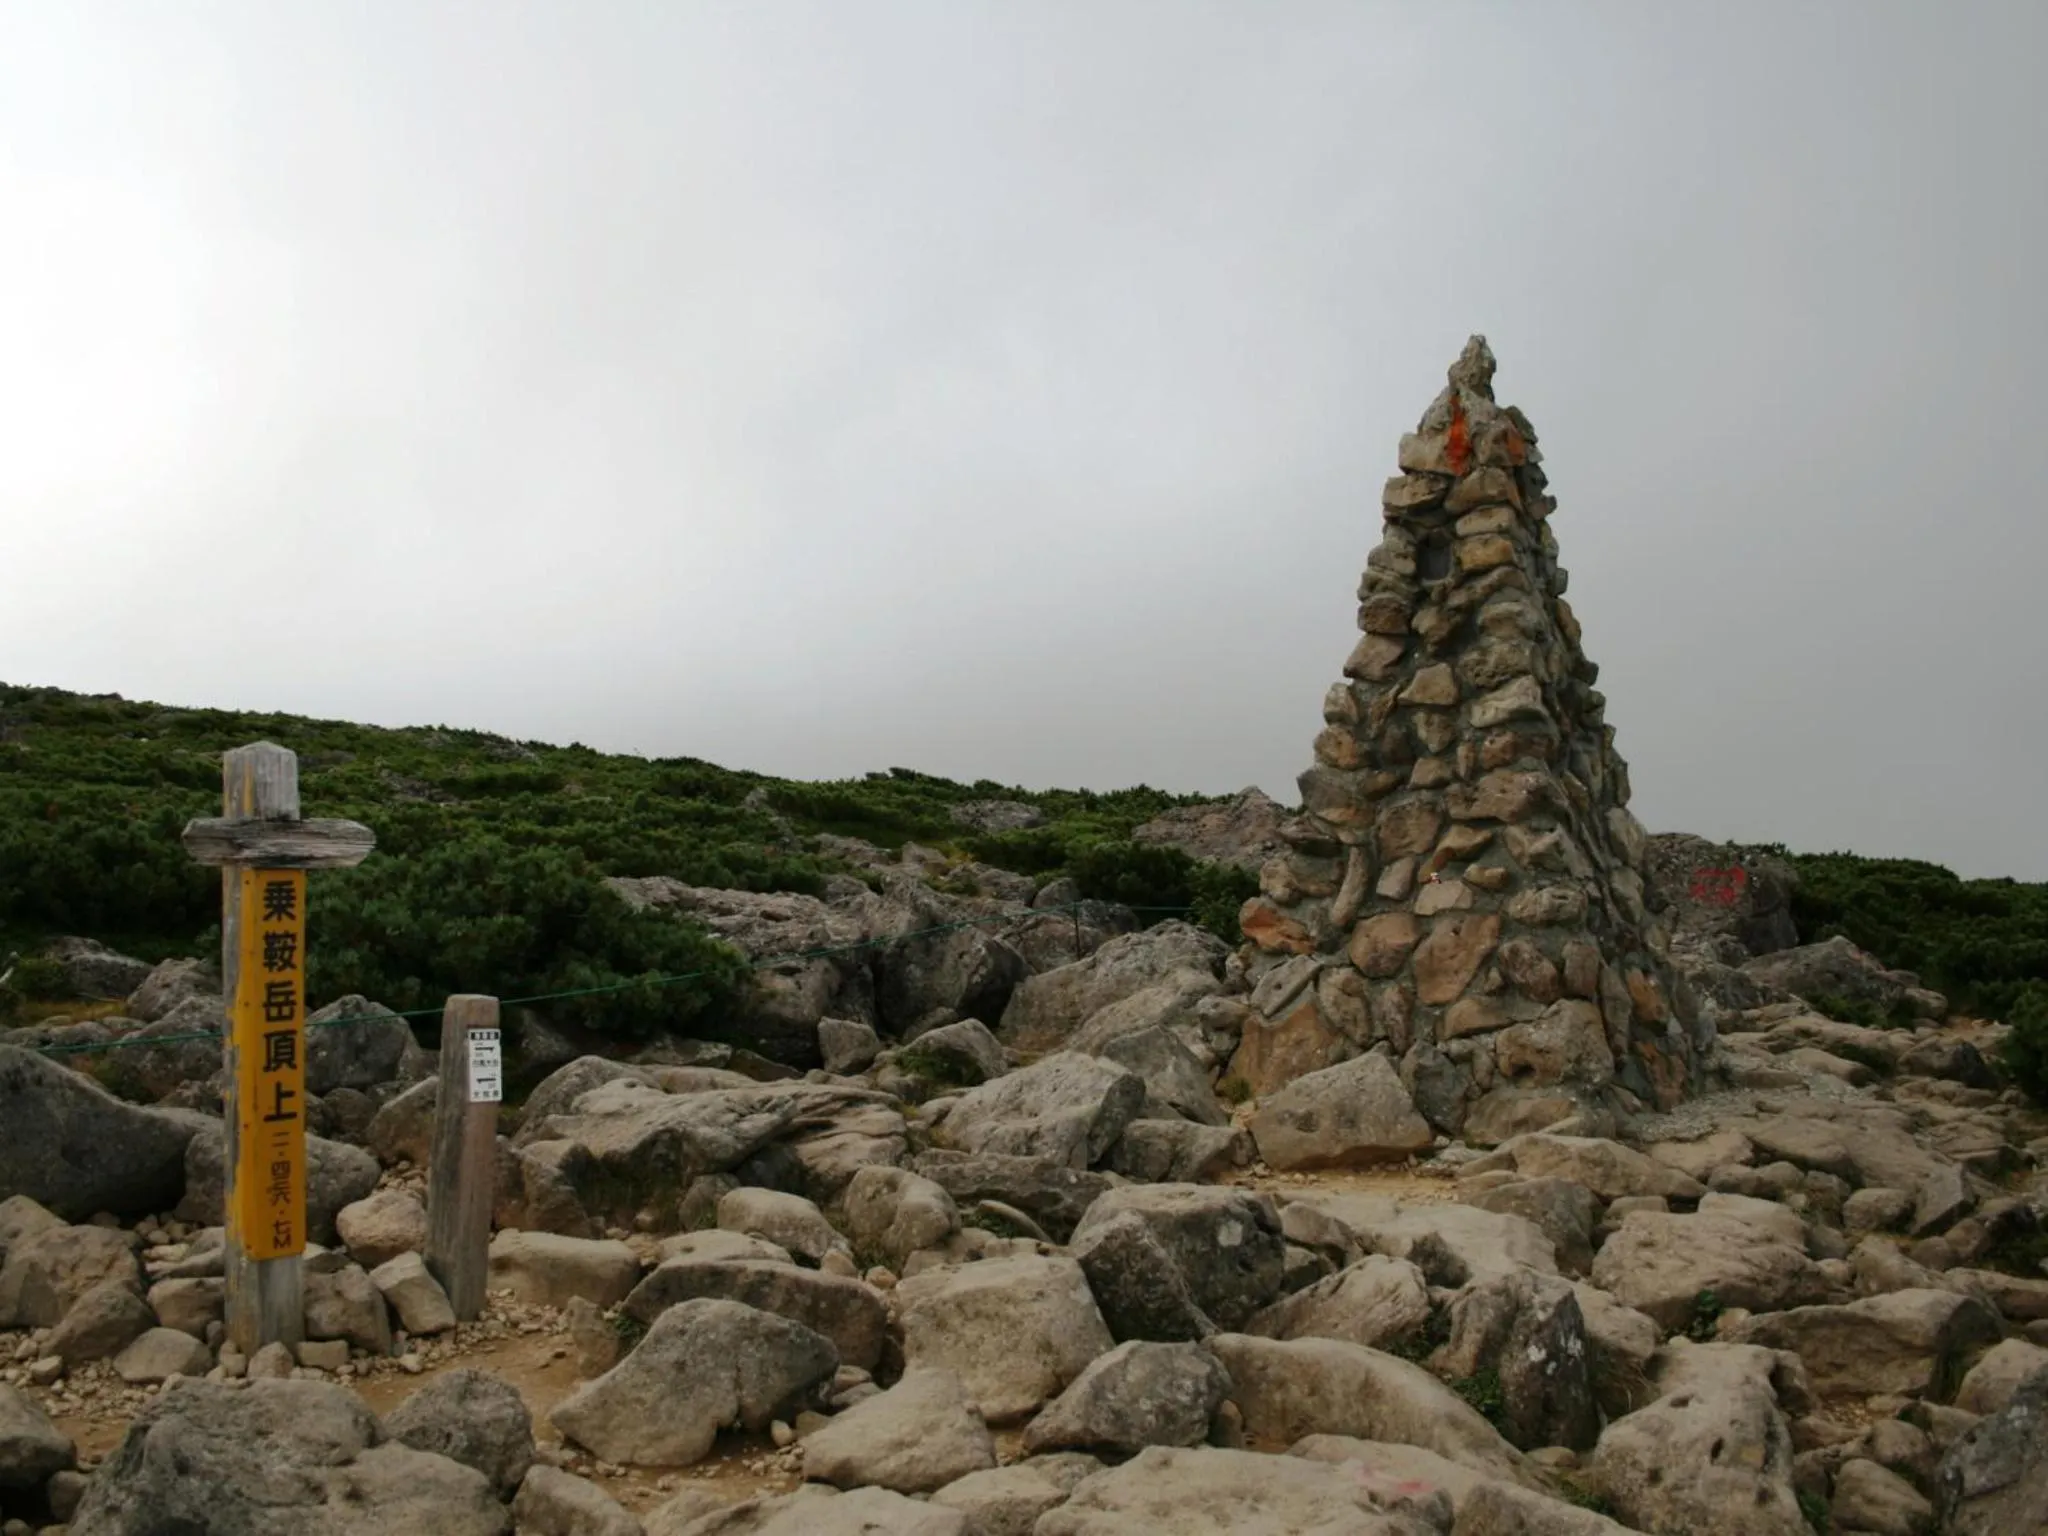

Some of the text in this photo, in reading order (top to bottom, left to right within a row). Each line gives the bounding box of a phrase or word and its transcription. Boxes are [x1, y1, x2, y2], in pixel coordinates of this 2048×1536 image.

[262, 880, 298, 1123] 乗鞍岳頂上
